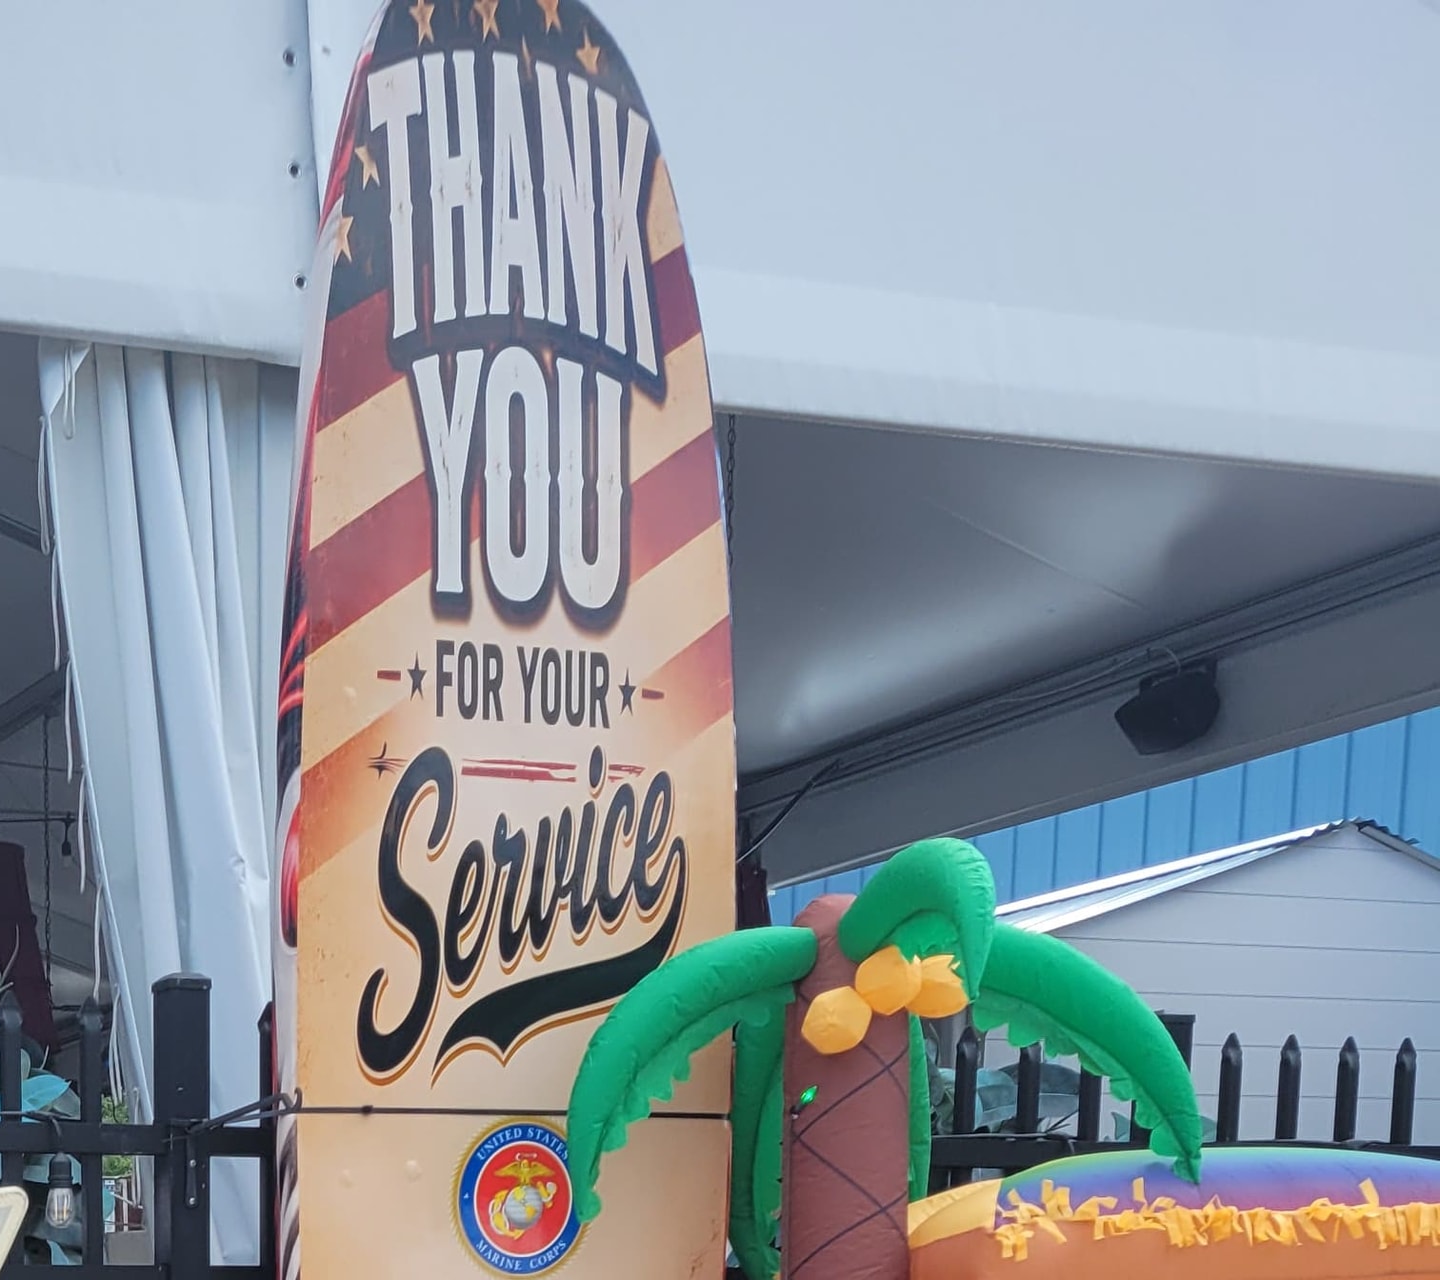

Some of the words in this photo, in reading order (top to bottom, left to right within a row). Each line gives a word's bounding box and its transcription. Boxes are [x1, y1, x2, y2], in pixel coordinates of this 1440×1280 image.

[368, 50, 658, 377] THANK
[412, 346, 623, 609] YOU
[435, 640, 504, 720] FOR
[517, 646, 610, 728] YOUR
[357, 745, 689, 1086] Service
[476, 1127, 522, 1161] UNITED
[527, 1127, 568, 1161] STATES
[476, 1239, 522, 1271] MARINE
[529, 1240, 567, 1269] CORPS
